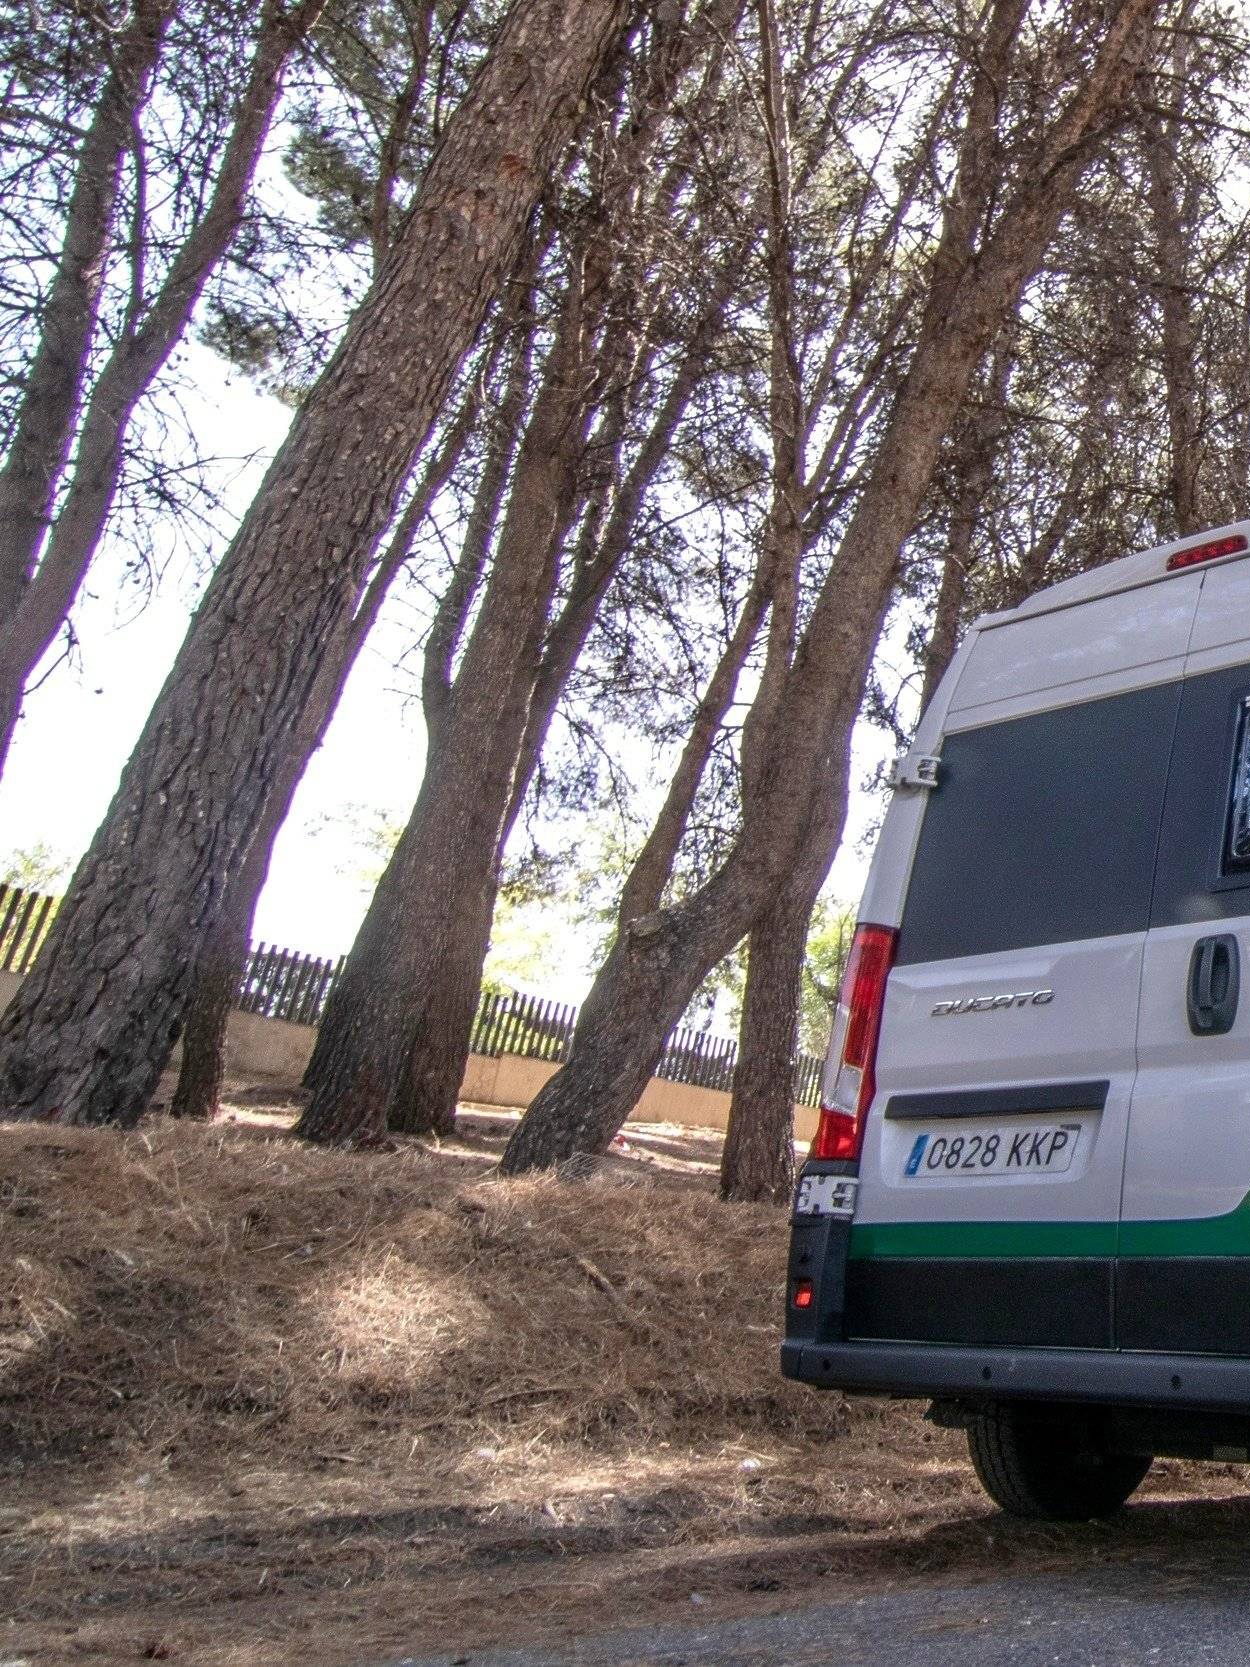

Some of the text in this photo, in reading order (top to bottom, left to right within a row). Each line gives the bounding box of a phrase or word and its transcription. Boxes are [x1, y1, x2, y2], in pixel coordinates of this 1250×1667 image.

[930, 989, 1055, 1017] DUCATO
[926, 1134, 1000, 1170] 0828
[1006, 1131, 1069, 1167] KKP
